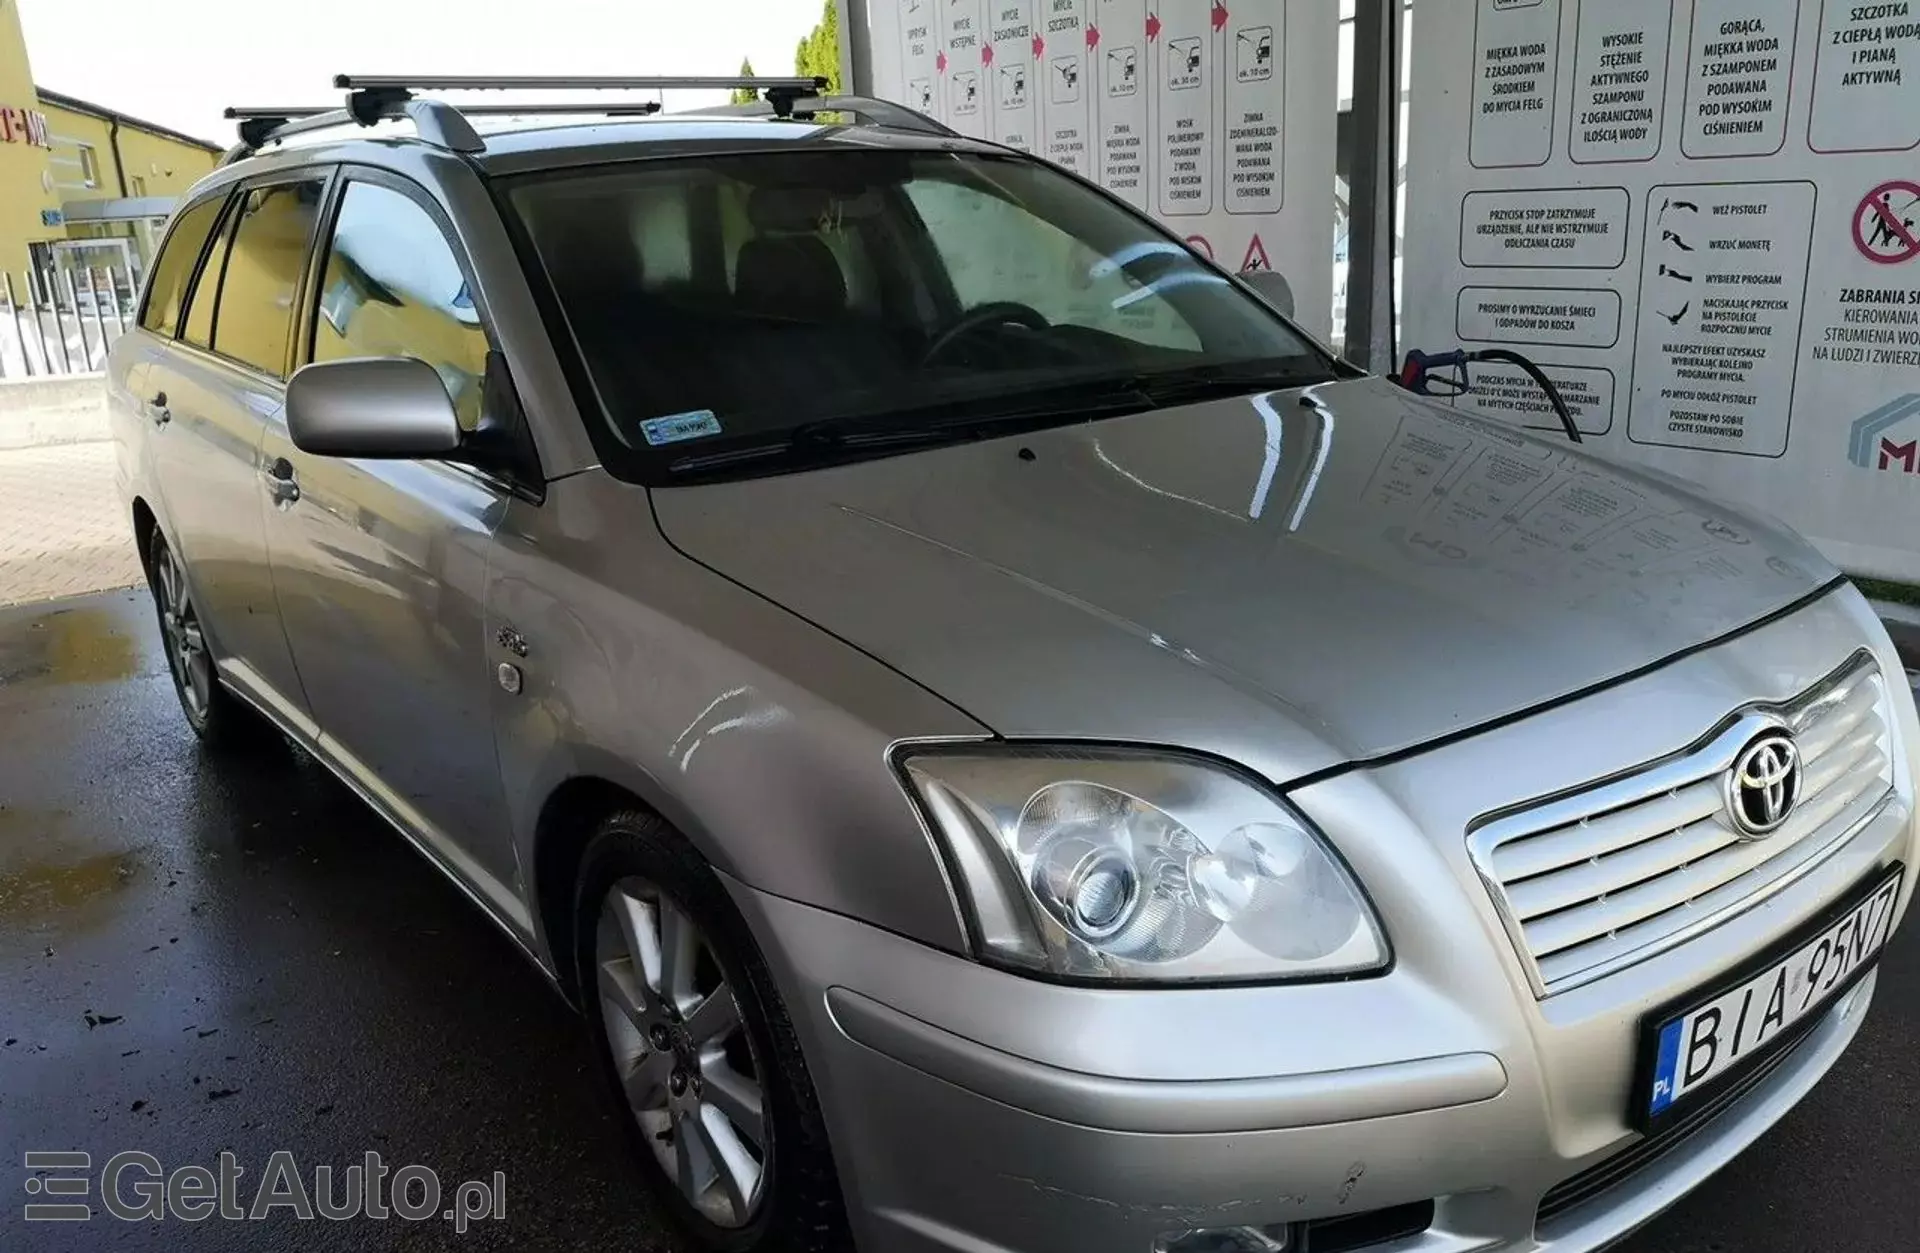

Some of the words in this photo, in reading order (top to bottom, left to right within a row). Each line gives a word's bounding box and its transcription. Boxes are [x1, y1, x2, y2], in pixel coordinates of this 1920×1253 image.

[1850, 2, 1909, 21] SZCZOTKA
[1720, 19, 1765, 36] GORĄCA,
[1832, 31, 1841, 44] Z
[1842, 27, 1881, 44] CIEPŁĄ
[1602, 32, 1644, 48] WYSOKIE
[1704, 40, 1743, 58] MIĘKKA
[1745, 38, 1779, 53] WODA
[1486, 47, 1518, 61] MIĘKKA
[1519, 43, 1546, 57] WODA
[1600, 51, 1642, 69] STĘŻENIE
[1852, 51, 1857, 64] I
[1859, 47, 1896, 63] PIANĄ
[1485, 67, 1491, 78] Z
[1491, 62, 1545, 78] ZASADOWYM
[1701, 64, 1708, 77] Z
[1710, 58, 1777, 76] SZAMPONEM
[1591, 70, 1649, 87] AKTYWNEGO
[1842, 69, 1901, 86] AKTYWNĄ
[1492, 81, 1535, 95] ŚRODKIEM
[1707, 80, 1767, 96] PODAWANA
[1483, 102, 1495, 113] DO
[1496, 100, 1521, 112] MYCIA
[1522, 98, 1544, 110] FELG
[1592, 90, 1645, 105] SZAMPONU
[1699, 103, 1720, 116] POD
[1722, 99, 1772, 115] WYSOKIM
[1581, 113, 1587, 125] Z
[1588, 108, 1653, 124] OGRANICZONĄ
[1584, 129, 1618, 143] ILOŚCIĄ
[1619, 128, 1648, 141] WODY
[1703, 120, 1763, 135] CIŚNIENIEM
[1489, 209, 1525, 220] PRZYCISK
[1526, 209, 1545, 220] STOP
[1546, 208, 1596, 219] ZATRZYMUJE
[1730, 204, 1768, 215] PISTOLET
[1476, 224, 1523, 236] URZĄDZENIE,
[1526, 223, 1540, 234] ALE
[1541, 223, 1554, 234] NIE
[1555, 223, 1609, 234] WSTRZYMUJE
[1504, 238, 1550, 248] ODLICZANIA
[1551, 238, 1576, 248] CZASU
[1709, 239, 1737, 249] WRZUĆ
[1738, 240, 1772, 252] MONETĘ
[1706, 274, 1740, 284] WYBIERZ
[1741, 274, 1782, 284] PROGRAM
[1839, 288, 1904, 304] ZABRANIA
[1478, 303, 1511, 313] PROSIMY
[1511, 304, 1518, 314] O
[1519, 304, 1567, 316] WYRZUCANIE
[1569, 305, 1596, 318] ŚMIECI
[1703, 299, 1749, 310] NACISKAJĄC
[1750, 300, 1789, 310] PRZYCISK
[1499, 318, 1536, 329] ODPADÓW
[1538, 320, 1549, 329] DO
[1550, 320, 1575, 330] KOSZA
[1702, 311, 1713, 320] NA
[1714, 312, 1757, 322] PISTOLECIE
[1843, 308, 1918, 325] KIEROWANIA
[1748, 326, 1772, 336] MYCIE
[1824, 327, 1895, 344] STRUMIENIA
[1898, 331, 1920, 346] WO
[1662, 344, 1701, 354] NAJLEPSZY
[1701, 346, 1726, 356] EFEKT
[1726, 347, 1766, 358] UZYSKASZ
[1812, 347, 1828, 360] NA
[1831, 348, 1864, 362] LUDZI
[1865, 350, 1871, 363] I
[1671, 357, 1717, 370] WYBIERAJĄC
[1718, 358, 1754, 370] KOLEJNO
[1676, 369, 1717, 381] PROGRAMY
[1719, 372, 1746, 382] MYCIA.
[1661, 389, 1671, 398] PO
[1672, 390, 1695, 400] MYCIU
[1721, 394, 1757, 405] PISTOLET
[1669, 410, 1708, 421] POZOSTAW
[1710, 413, 1720, 423] PO
[1721, 414, 1744, 425] SOBIE
[1668, 422, 1694, 433] CZYSTE
[1694, 424, 1744, 438] STANOWISKO
[1683, 966, 1787, 1088] BIA
[1800, 884, 1894, 1010] 95N7
[1653, 1076, 1670, 1101] PL
